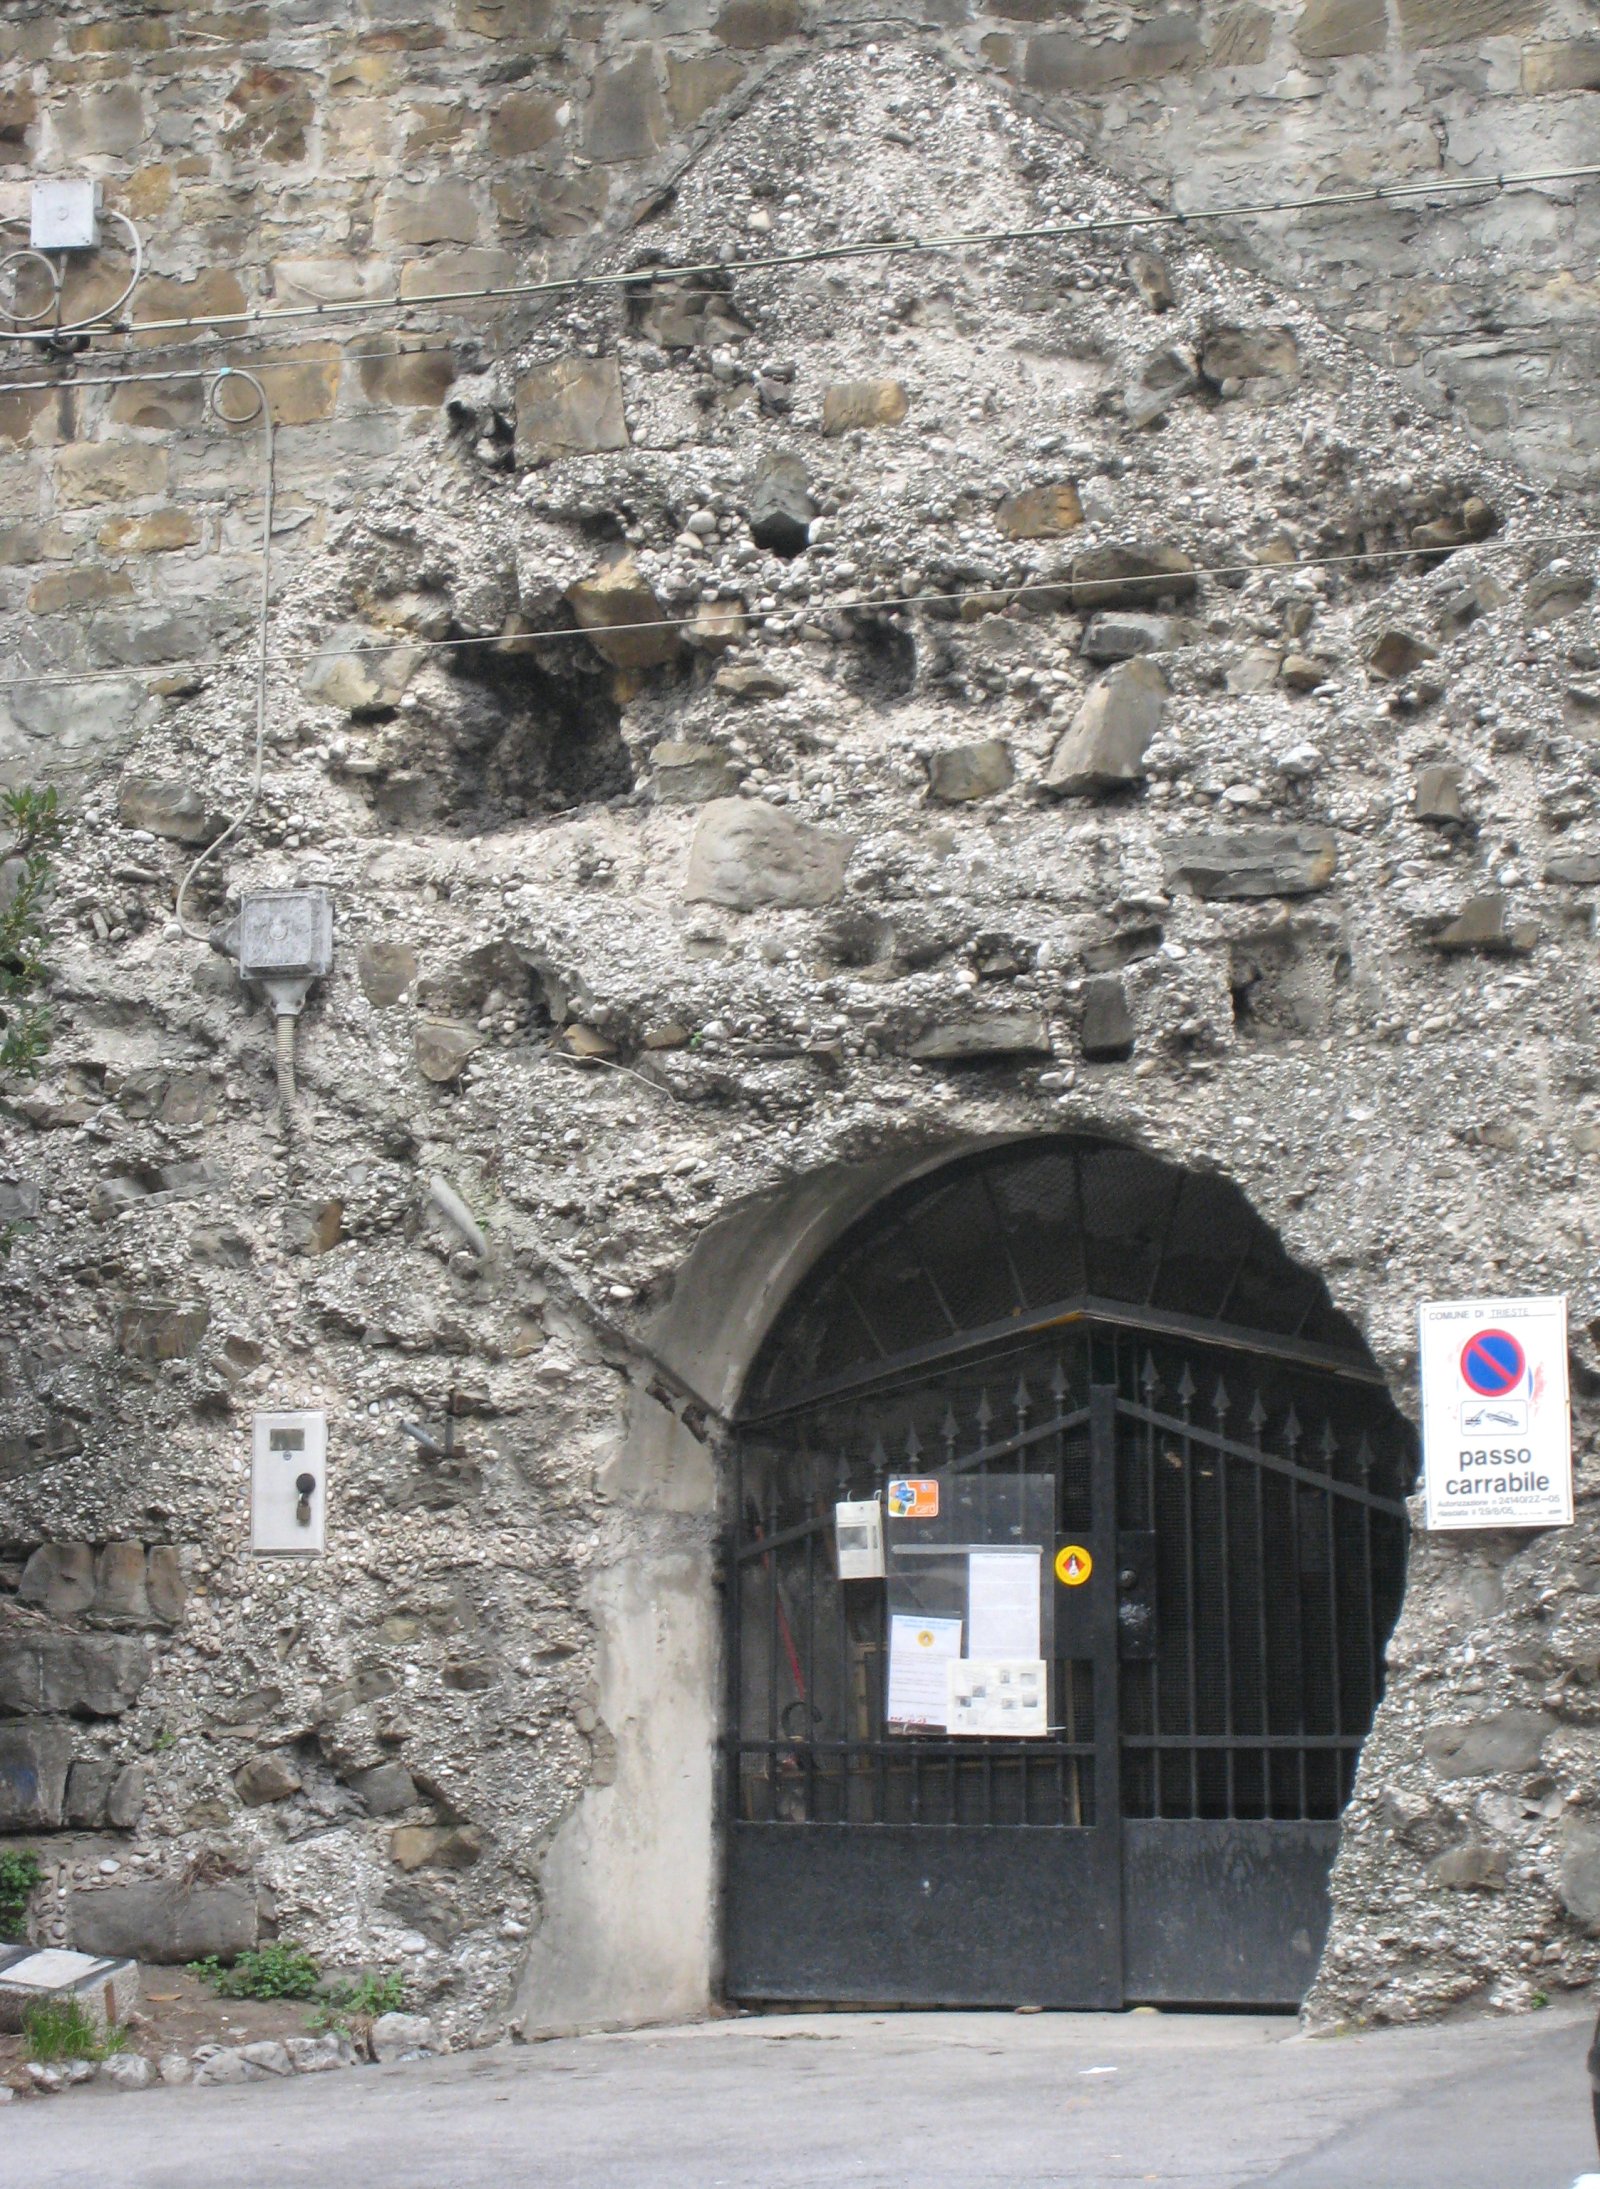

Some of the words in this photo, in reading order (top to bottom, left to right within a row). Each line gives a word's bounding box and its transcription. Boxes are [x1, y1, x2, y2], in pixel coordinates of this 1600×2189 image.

[1429, 1310, 1470, 1321] COMUNE
[1474, 1309, 1484, 1319] DI
[1491, 1308, 1529, 1318] TRIESTE
[1459, 1448, 1532, 1472] passo
[1446, 1471, 1550, 1495] carrabile
